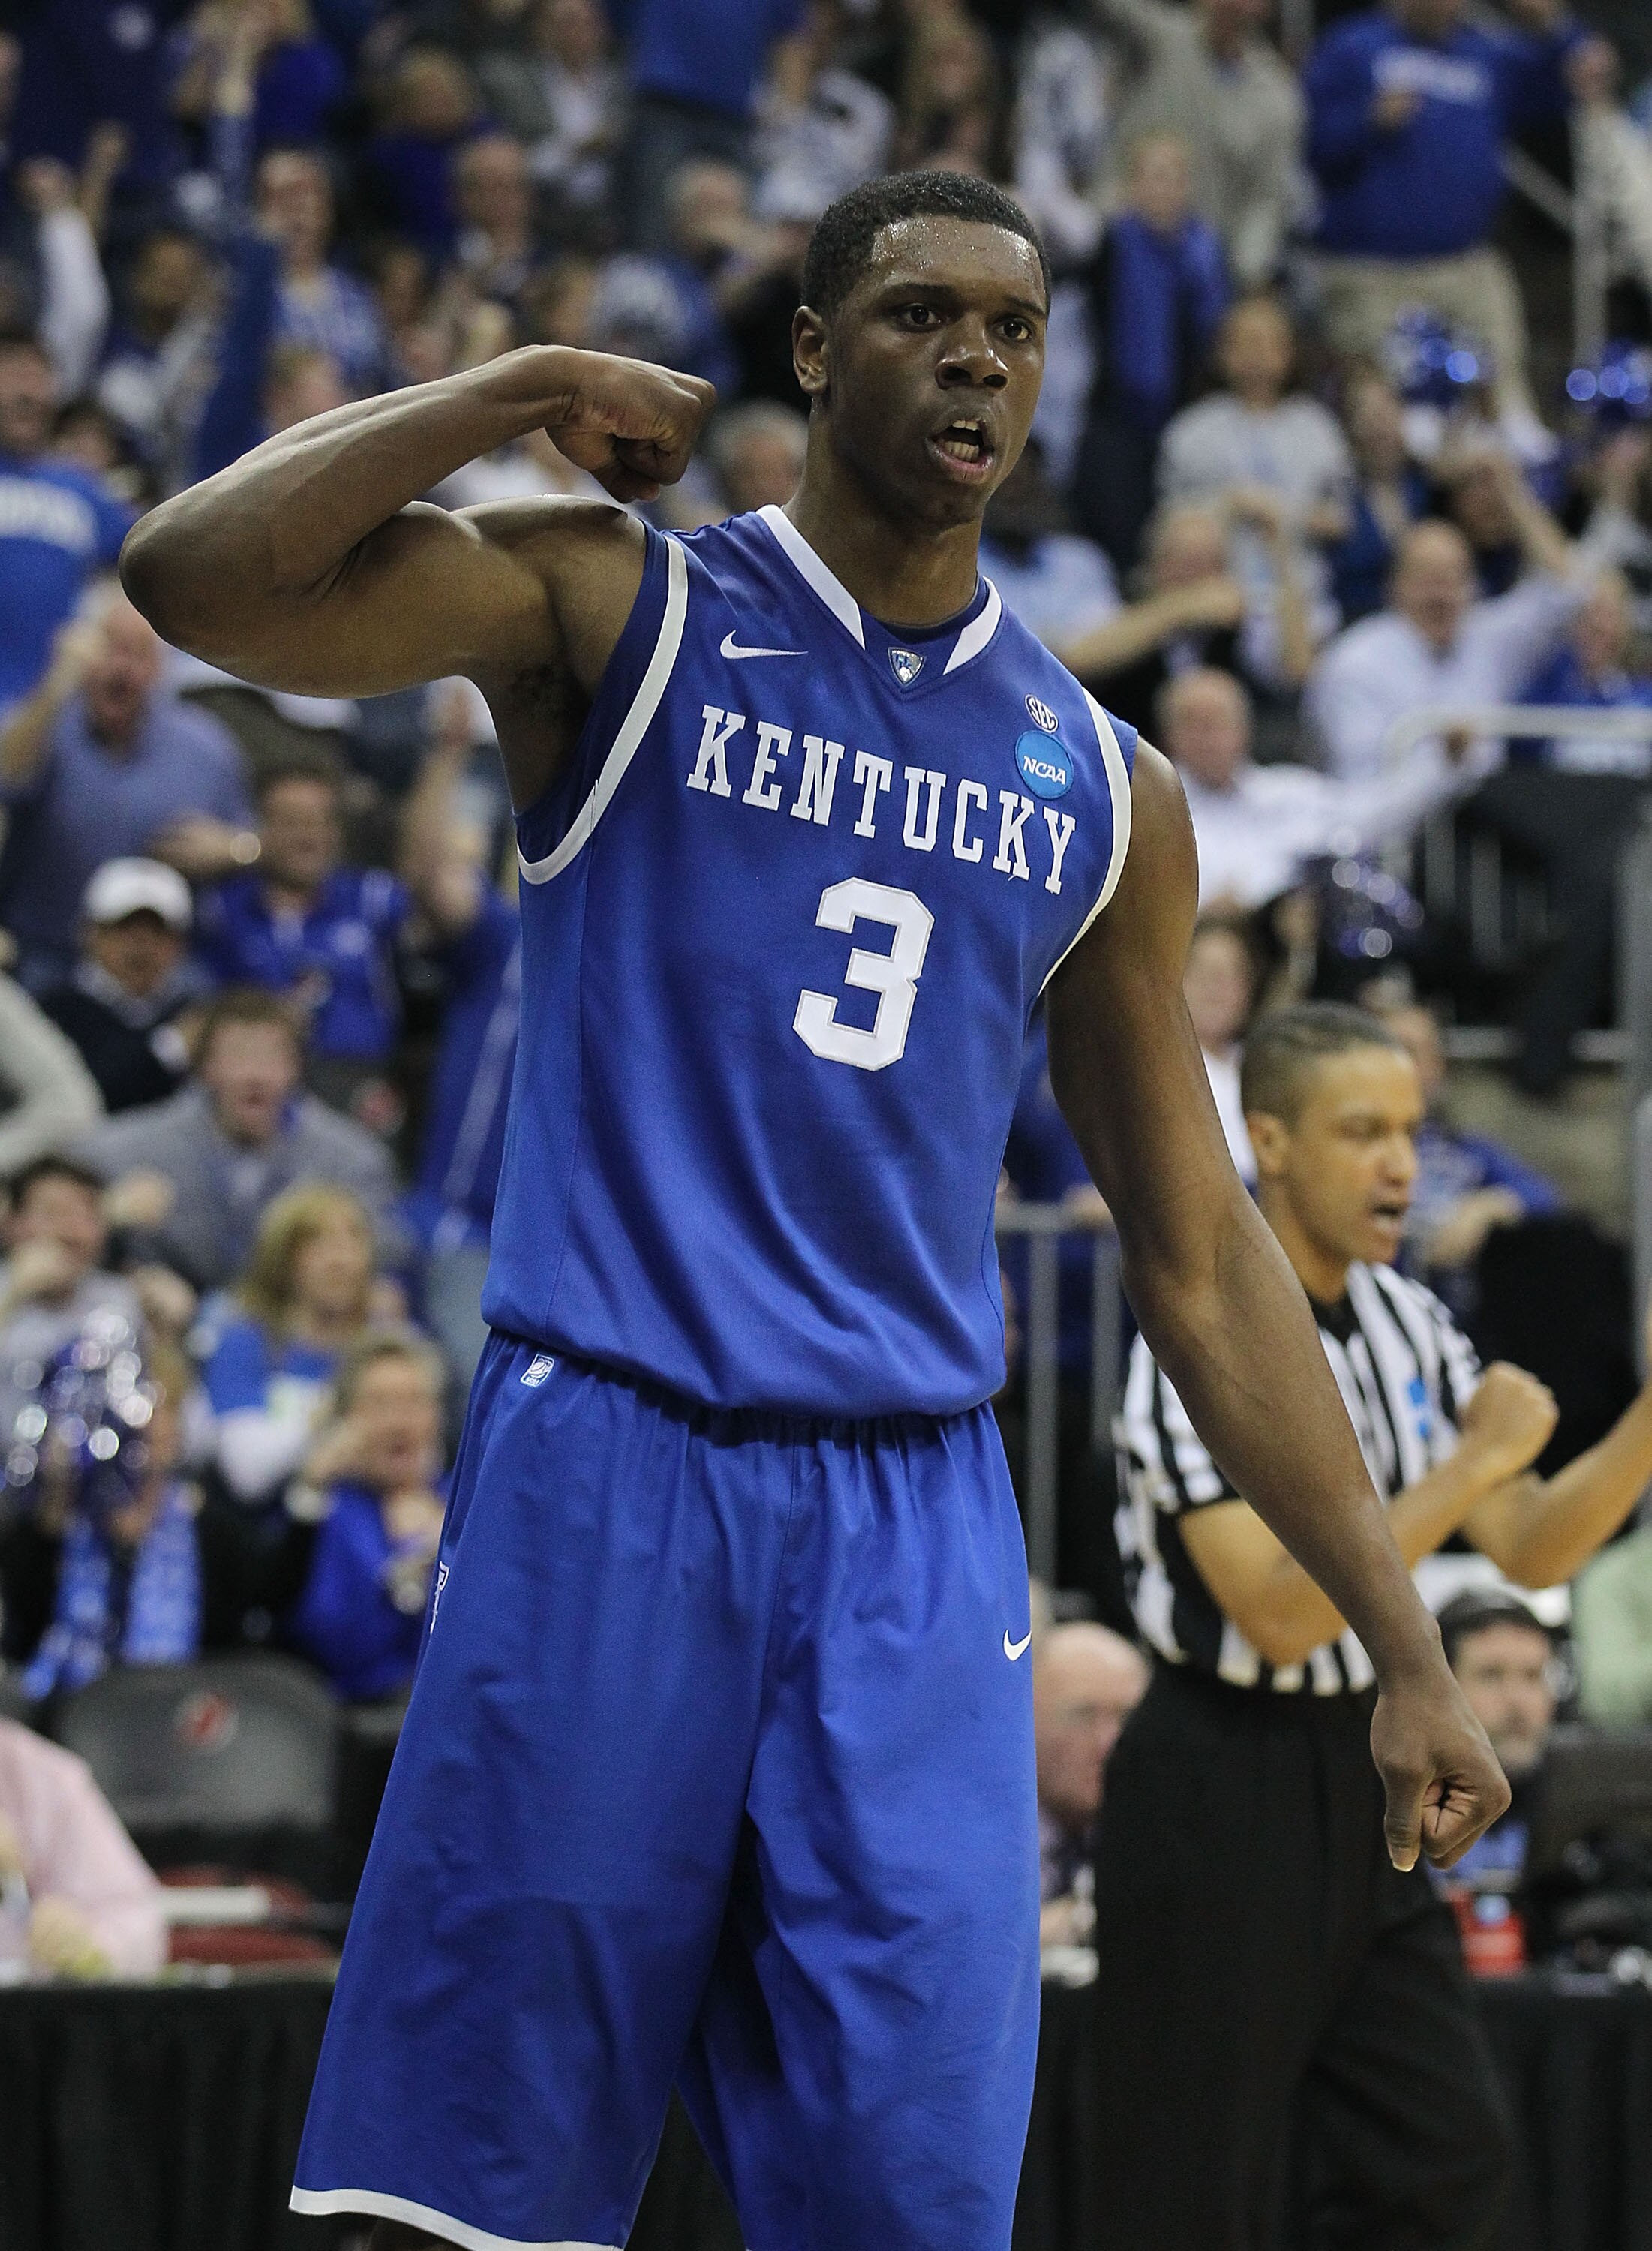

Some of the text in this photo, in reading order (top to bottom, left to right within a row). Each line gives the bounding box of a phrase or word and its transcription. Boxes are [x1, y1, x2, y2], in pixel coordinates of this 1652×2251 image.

[1027, 696, 1056, 729] SEC
[686, 705, 1076, 894] KENTUCKY
[1023, 755, 1066, 785] NCAA
[792, 876, 935, 1071] 3
